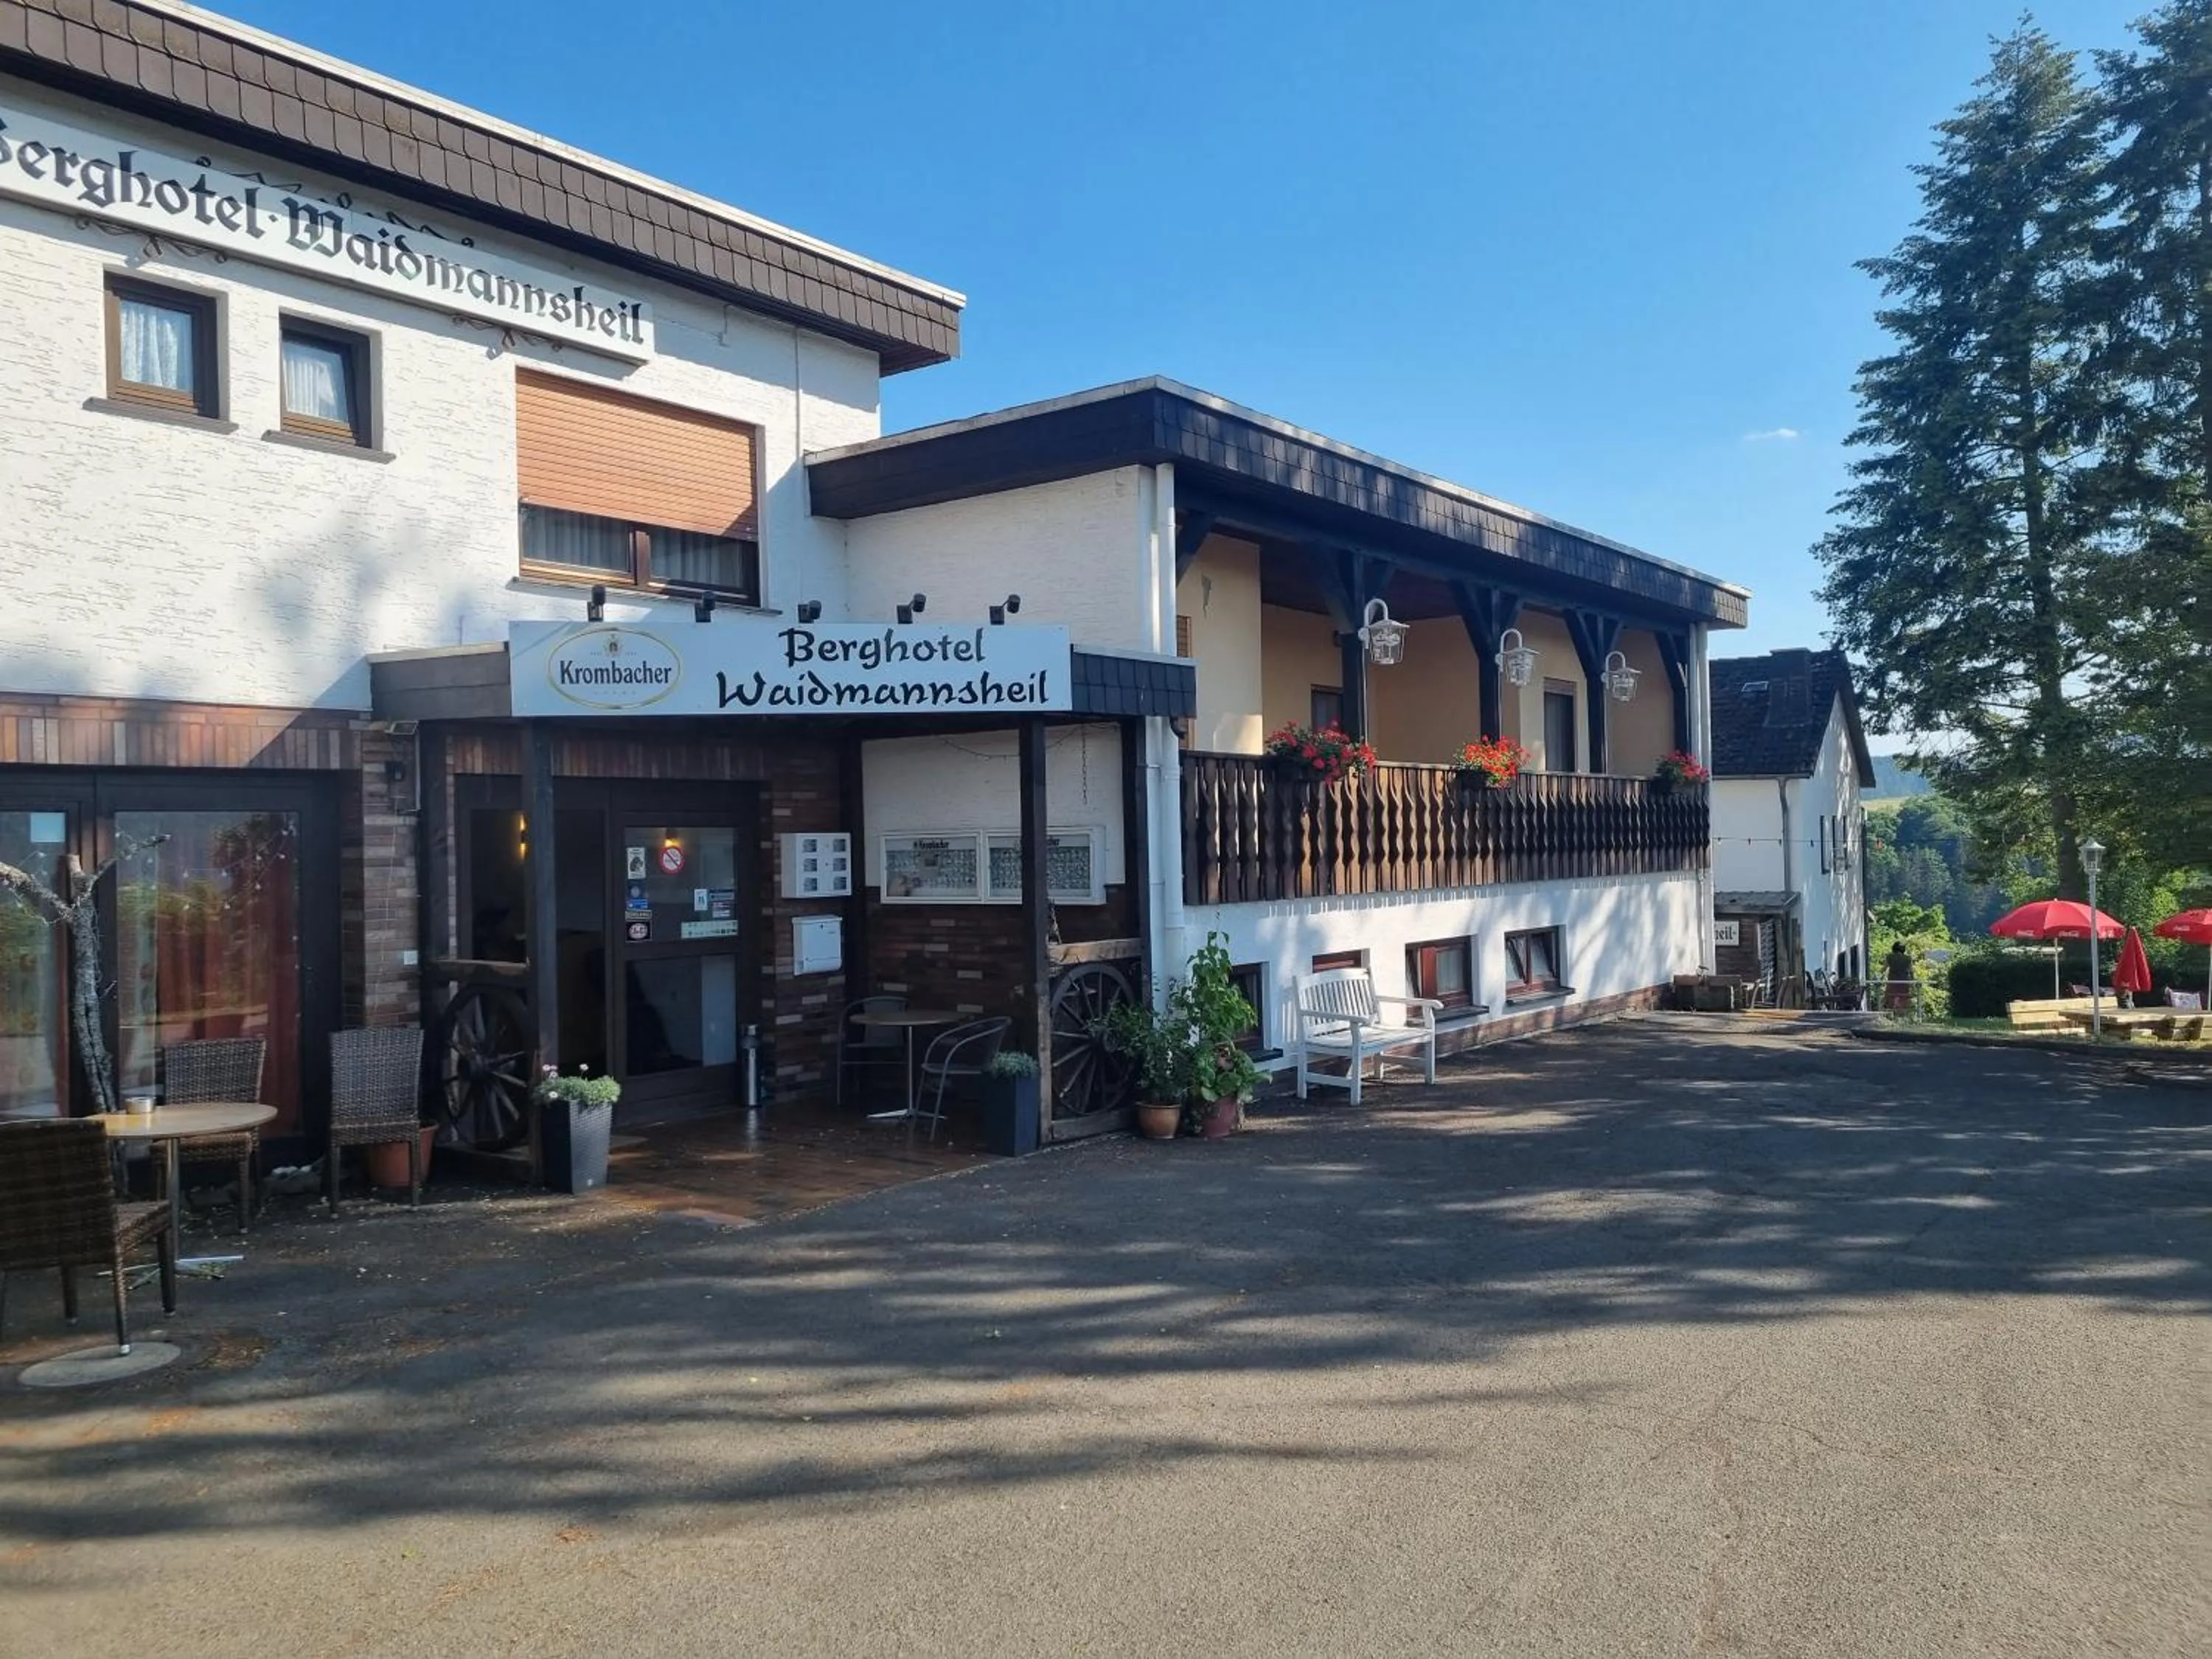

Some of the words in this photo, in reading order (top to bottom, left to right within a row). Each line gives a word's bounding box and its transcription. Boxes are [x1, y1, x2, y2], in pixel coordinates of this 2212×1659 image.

[286, 193, 646, 345] Waidmannsheil
[778, 627, 986, 669] Berghotel
[560, 660, 672, 685] Krombacher
[716, 669, 1050, 709] Waidmannsheil
